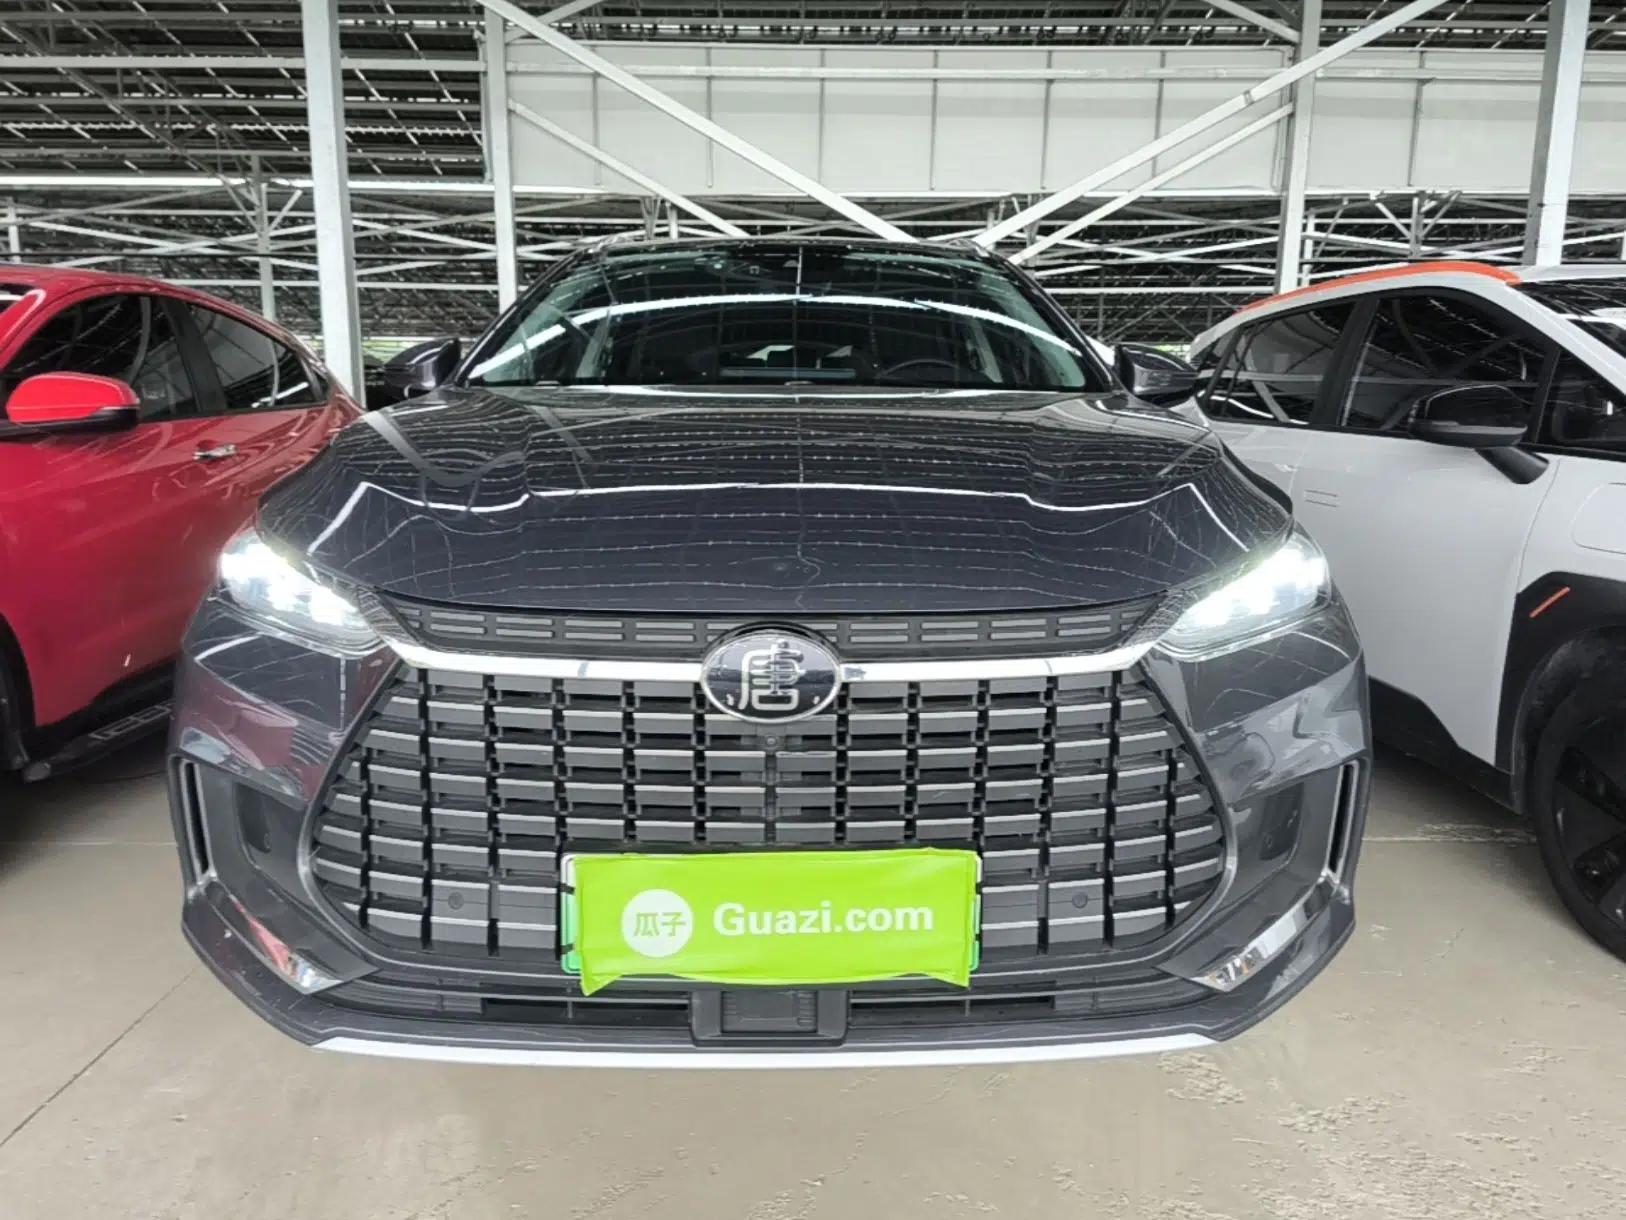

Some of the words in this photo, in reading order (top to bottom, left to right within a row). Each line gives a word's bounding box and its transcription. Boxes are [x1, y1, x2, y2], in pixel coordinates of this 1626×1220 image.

[738, 641, 806, 711] 唐
[633, 911, 687, 938] 瓜子
[713, 901, 933, 936] Guazi.com
